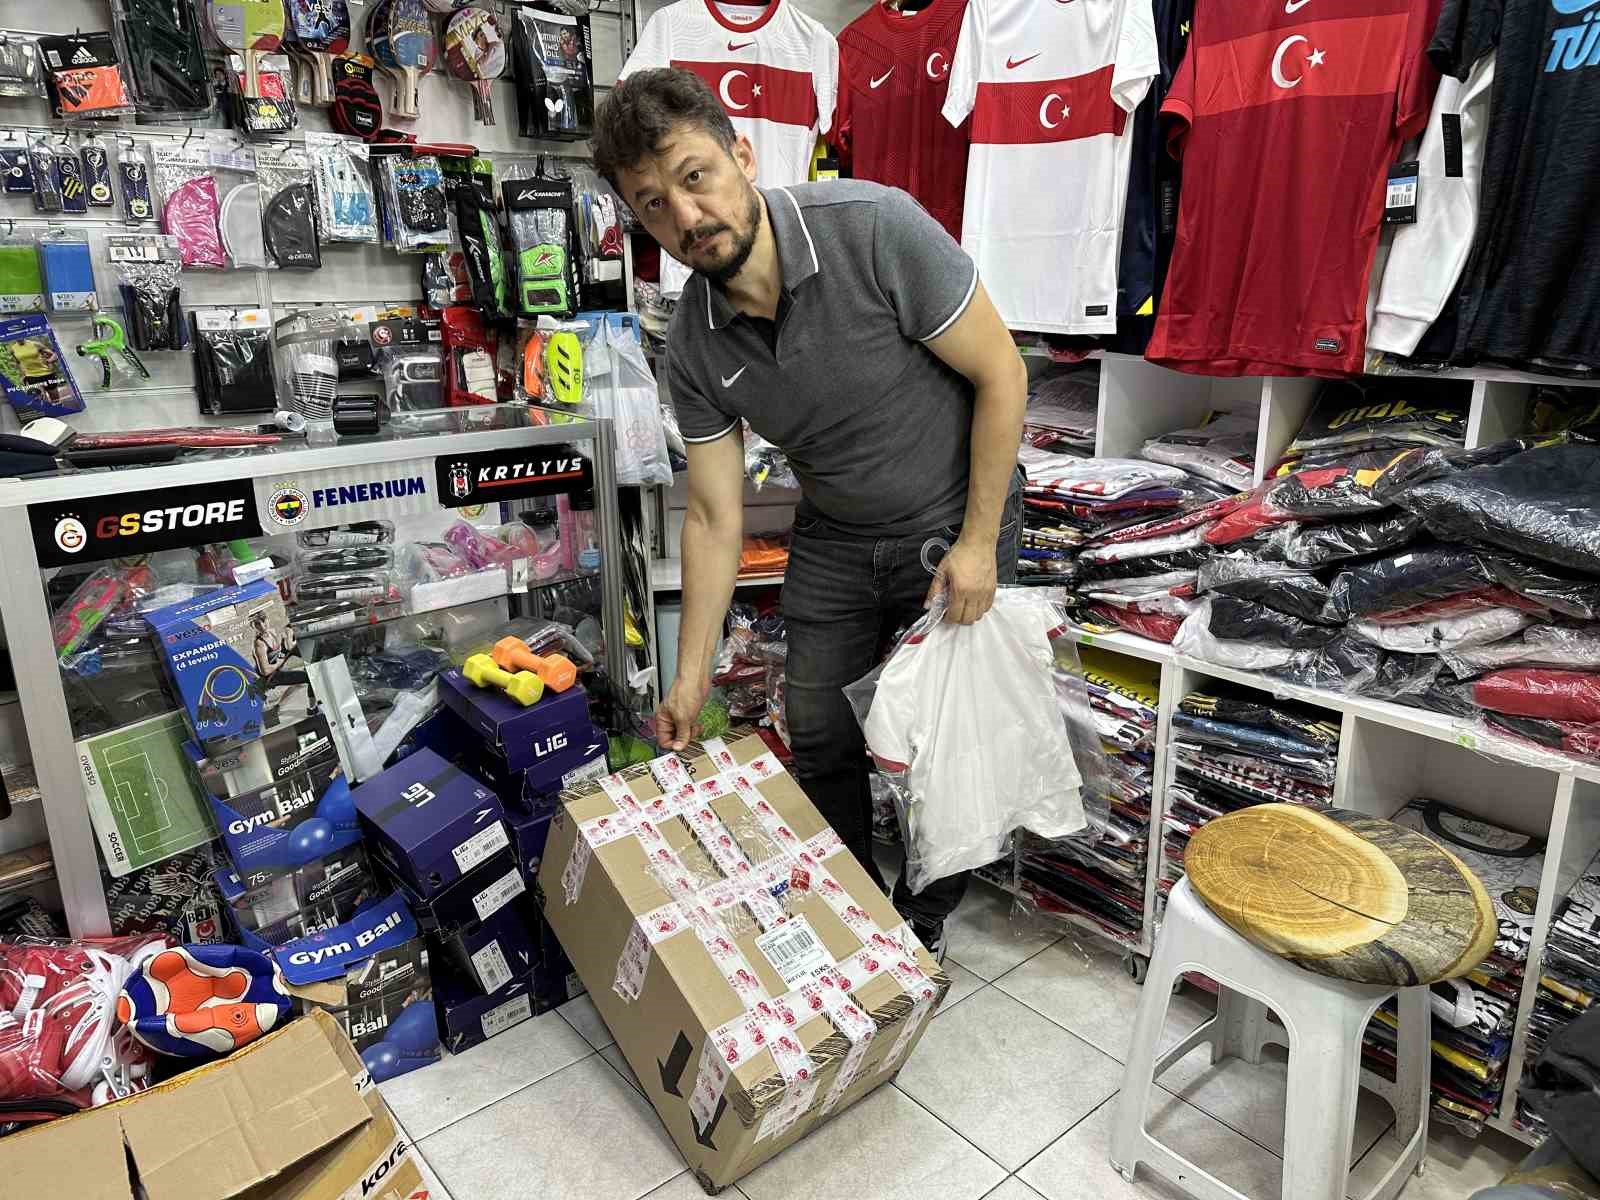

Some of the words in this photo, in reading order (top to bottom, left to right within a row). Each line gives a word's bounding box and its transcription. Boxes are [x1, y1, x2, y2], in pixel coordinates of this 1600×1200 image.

[478, 457, 582, 481] KRTLYVS
[312, 476, 426, 508] FENERIUM
[96, 499, 245, 539] GSSTORE
[172, 638, 227, 661] EXPANDER
[176, 660, 186, 671] (4
[188, 651, 218, 666] levels)
[278, 759, 300, 776] Good
[228, 809, 275, 835] Gym
[278, 789, 315, 815] Ball
[110, 832, 125, 863] SOCCER
[309, 884, 332, 901] Good
[289, 940, 352, 966] Gym
[356, 911, 402, 948] Ball
[359, 984, 382, 999] Good
[352, 1014, 388, 1037] Ball
